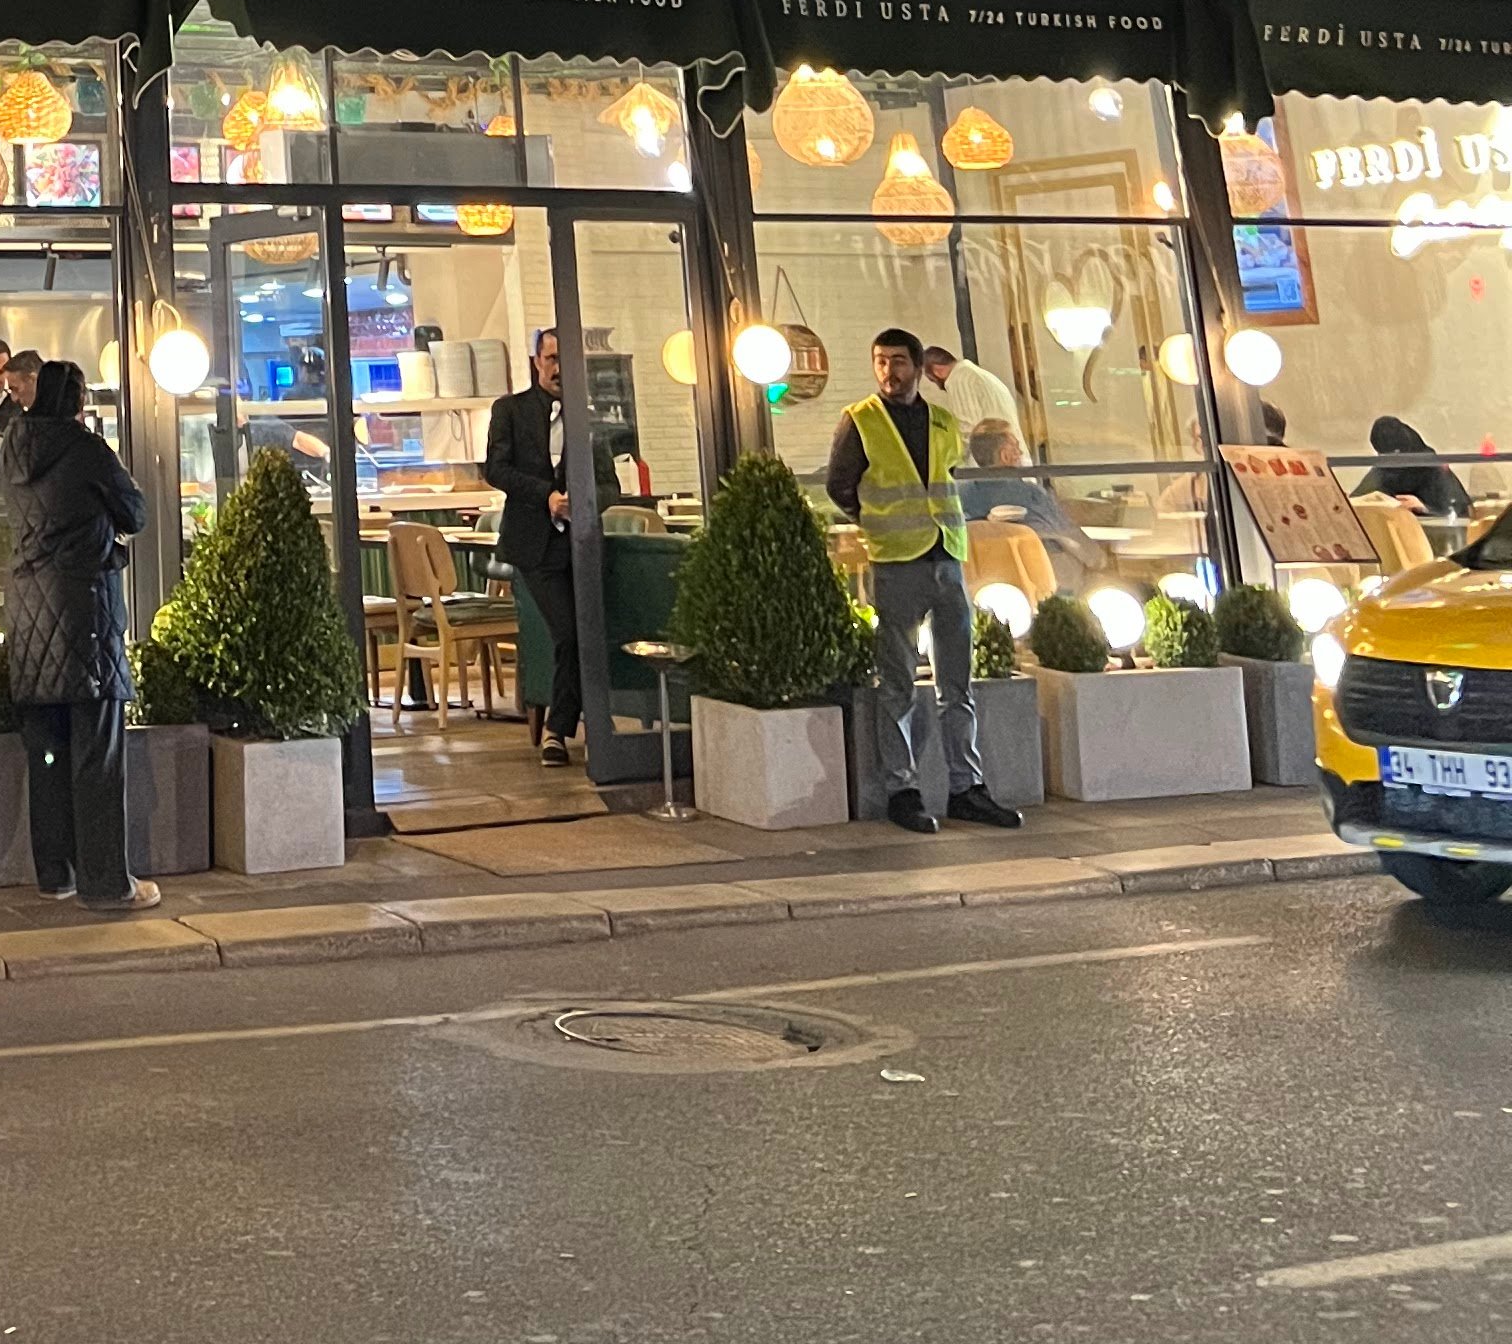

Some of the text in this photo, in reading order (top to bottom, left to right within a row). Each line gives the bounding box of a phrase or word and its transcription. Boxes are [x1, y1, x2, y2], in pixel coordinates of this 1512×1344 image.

[879, 1, 950, 22] USTA
[968, 9, 1004, 25] 7/24
[1015, 11, 1097, 28] TURKISH
[1108, 15, 1162, 30] FOOD
[1263, 23, 1344, 46] FERDİ
[1359, 30, 1422, 50] USTA
